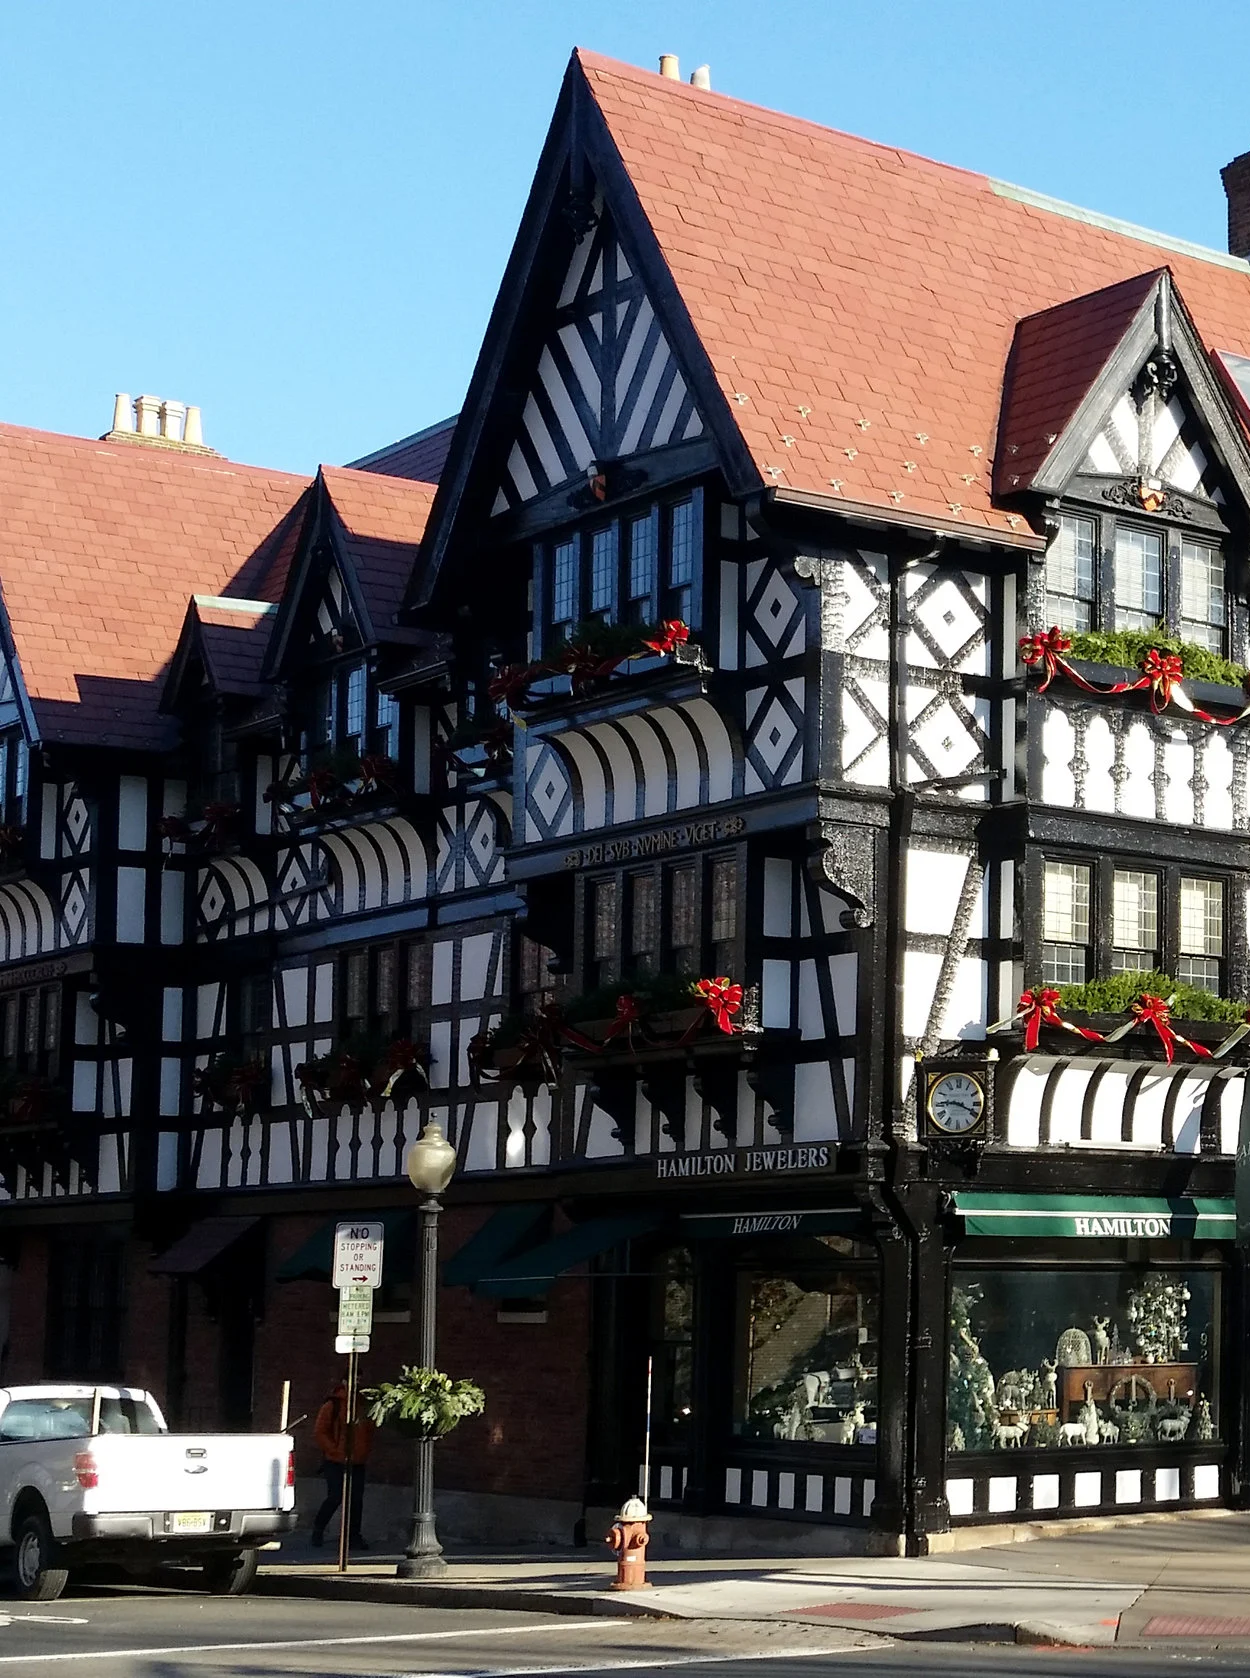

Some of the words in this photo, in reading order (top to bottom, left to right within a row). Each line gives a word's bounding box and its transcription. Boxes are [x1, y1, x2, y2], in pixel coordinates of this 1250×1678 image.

[587, 844, 603, 864] DEI
[684, 821, 717, 844] VIGET
[657, 1153, 735, 1178] HAMILTON
[744, 1146, 829, 1172] JEWELERS
[732, 1215, 802, 1234] HAMILTON
[1074, 1217, 1171, 1236] HAMILTON
[350, 1227, 369, 1239] NO
[340, 1242, 377, 1251] STOPPING
[353, 1253, 364, 1261] OR
[340, 1263, 376, 1272] STANDING
